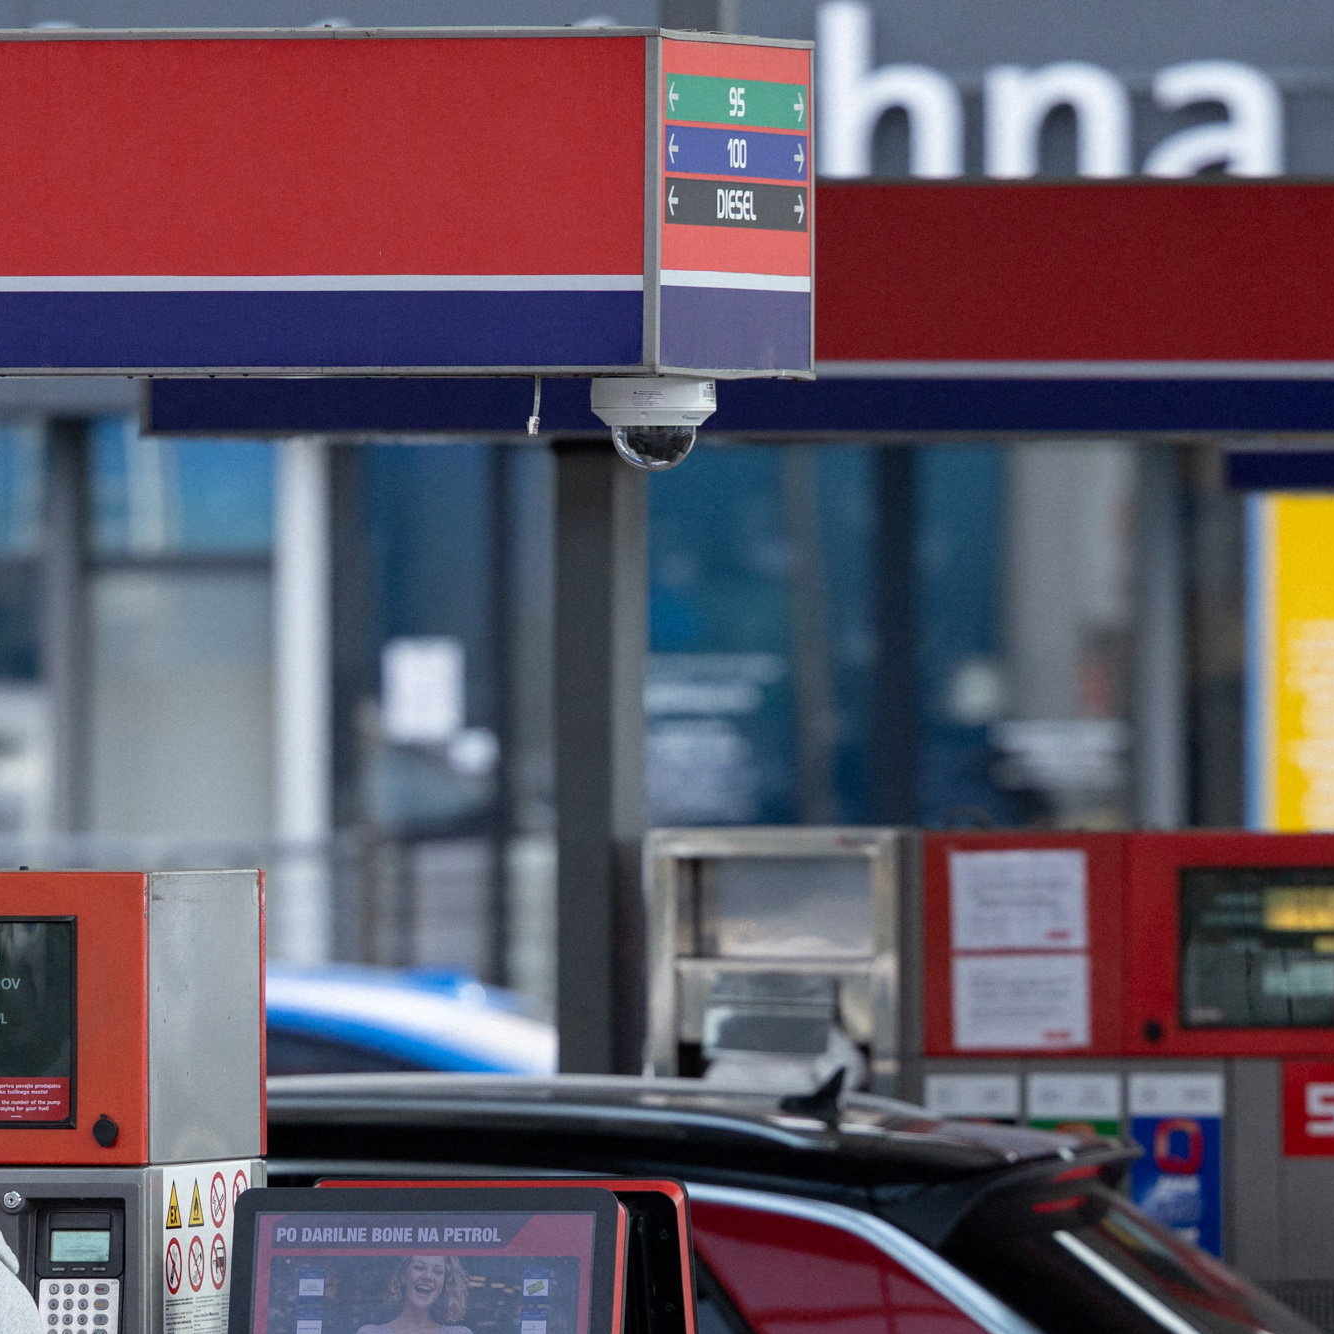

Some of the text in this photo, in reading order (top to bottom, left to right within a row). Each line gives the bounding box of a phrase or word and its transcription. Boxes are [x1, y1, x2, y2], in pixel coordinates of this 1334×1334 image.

[729, 86, 746, 117] 95
[727, 138, 747, 169] 100
[717, 188, 757, 221] DIESEL
[276, 1227, 502, 1242] PO DARILNE BONE NA PETROL
